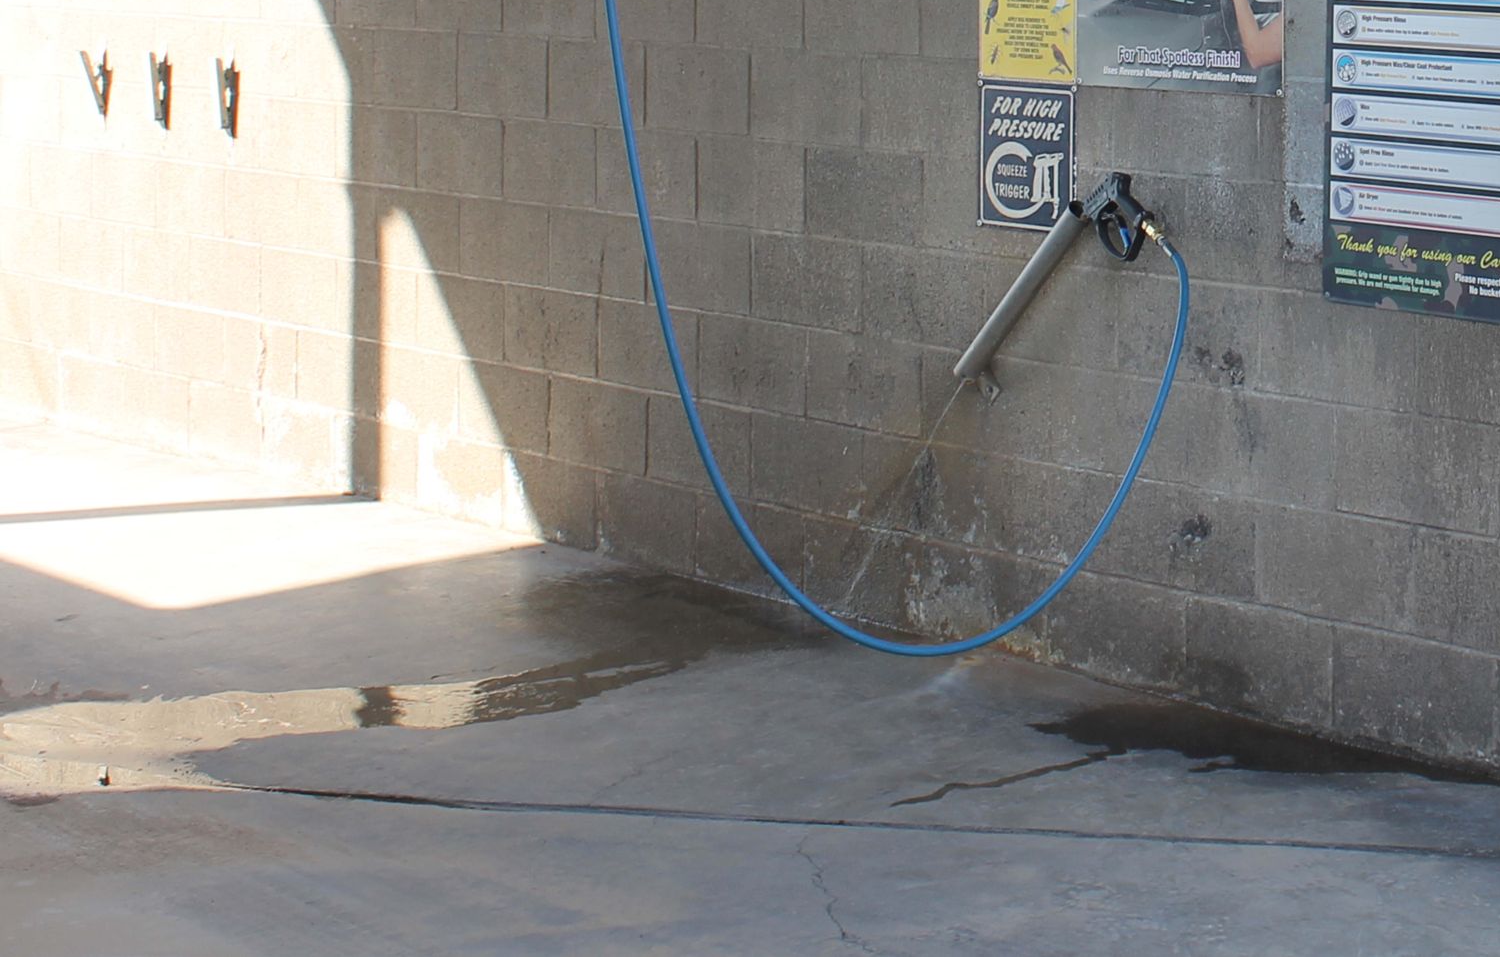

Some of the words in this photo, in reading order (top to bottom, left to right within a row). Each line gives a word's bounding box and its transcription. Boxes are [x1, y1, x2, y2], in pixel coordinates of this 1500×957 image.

[1117, 45, 1134, 64] For
[1137, 46, 1161, 64] That
[1162, 48, 1204, 67] Spotless
[1206, 50, 1240, 68] Finish!
[1361, 59, 1371, 67] High
[1372, 60, 1391, 68] Pressure
[1103, 66, 1118, 75] Uses
[1119, 67, 1144, 77] Reverse
[1145, 69, 1171, 78] Osmosis
[1172, 70, 1191, 79] Water
[1192, 71, 1230, 82] Purification
[1231, 73, 1257, 83] Process
[991, 96, 1022, 116] FOR
[1023, 98, 1062, 119] HIGH
[989, 119, 1065, 141] PRESSURE
[997, 163, 1028, 178] SQUEEZE
[994, 183, 1030, 199] TRIGGER
[1337, 234, 1374, 254] Thank
[1376, 244, 1397, 258] you
[1400, 244, 1418, 262] for
[1422, 249, 1452, 266] using
[1456, 254, 1476, 266] our
[1455, 273, 1476, 285] Please
[1469, 286, 1478, 294] No
